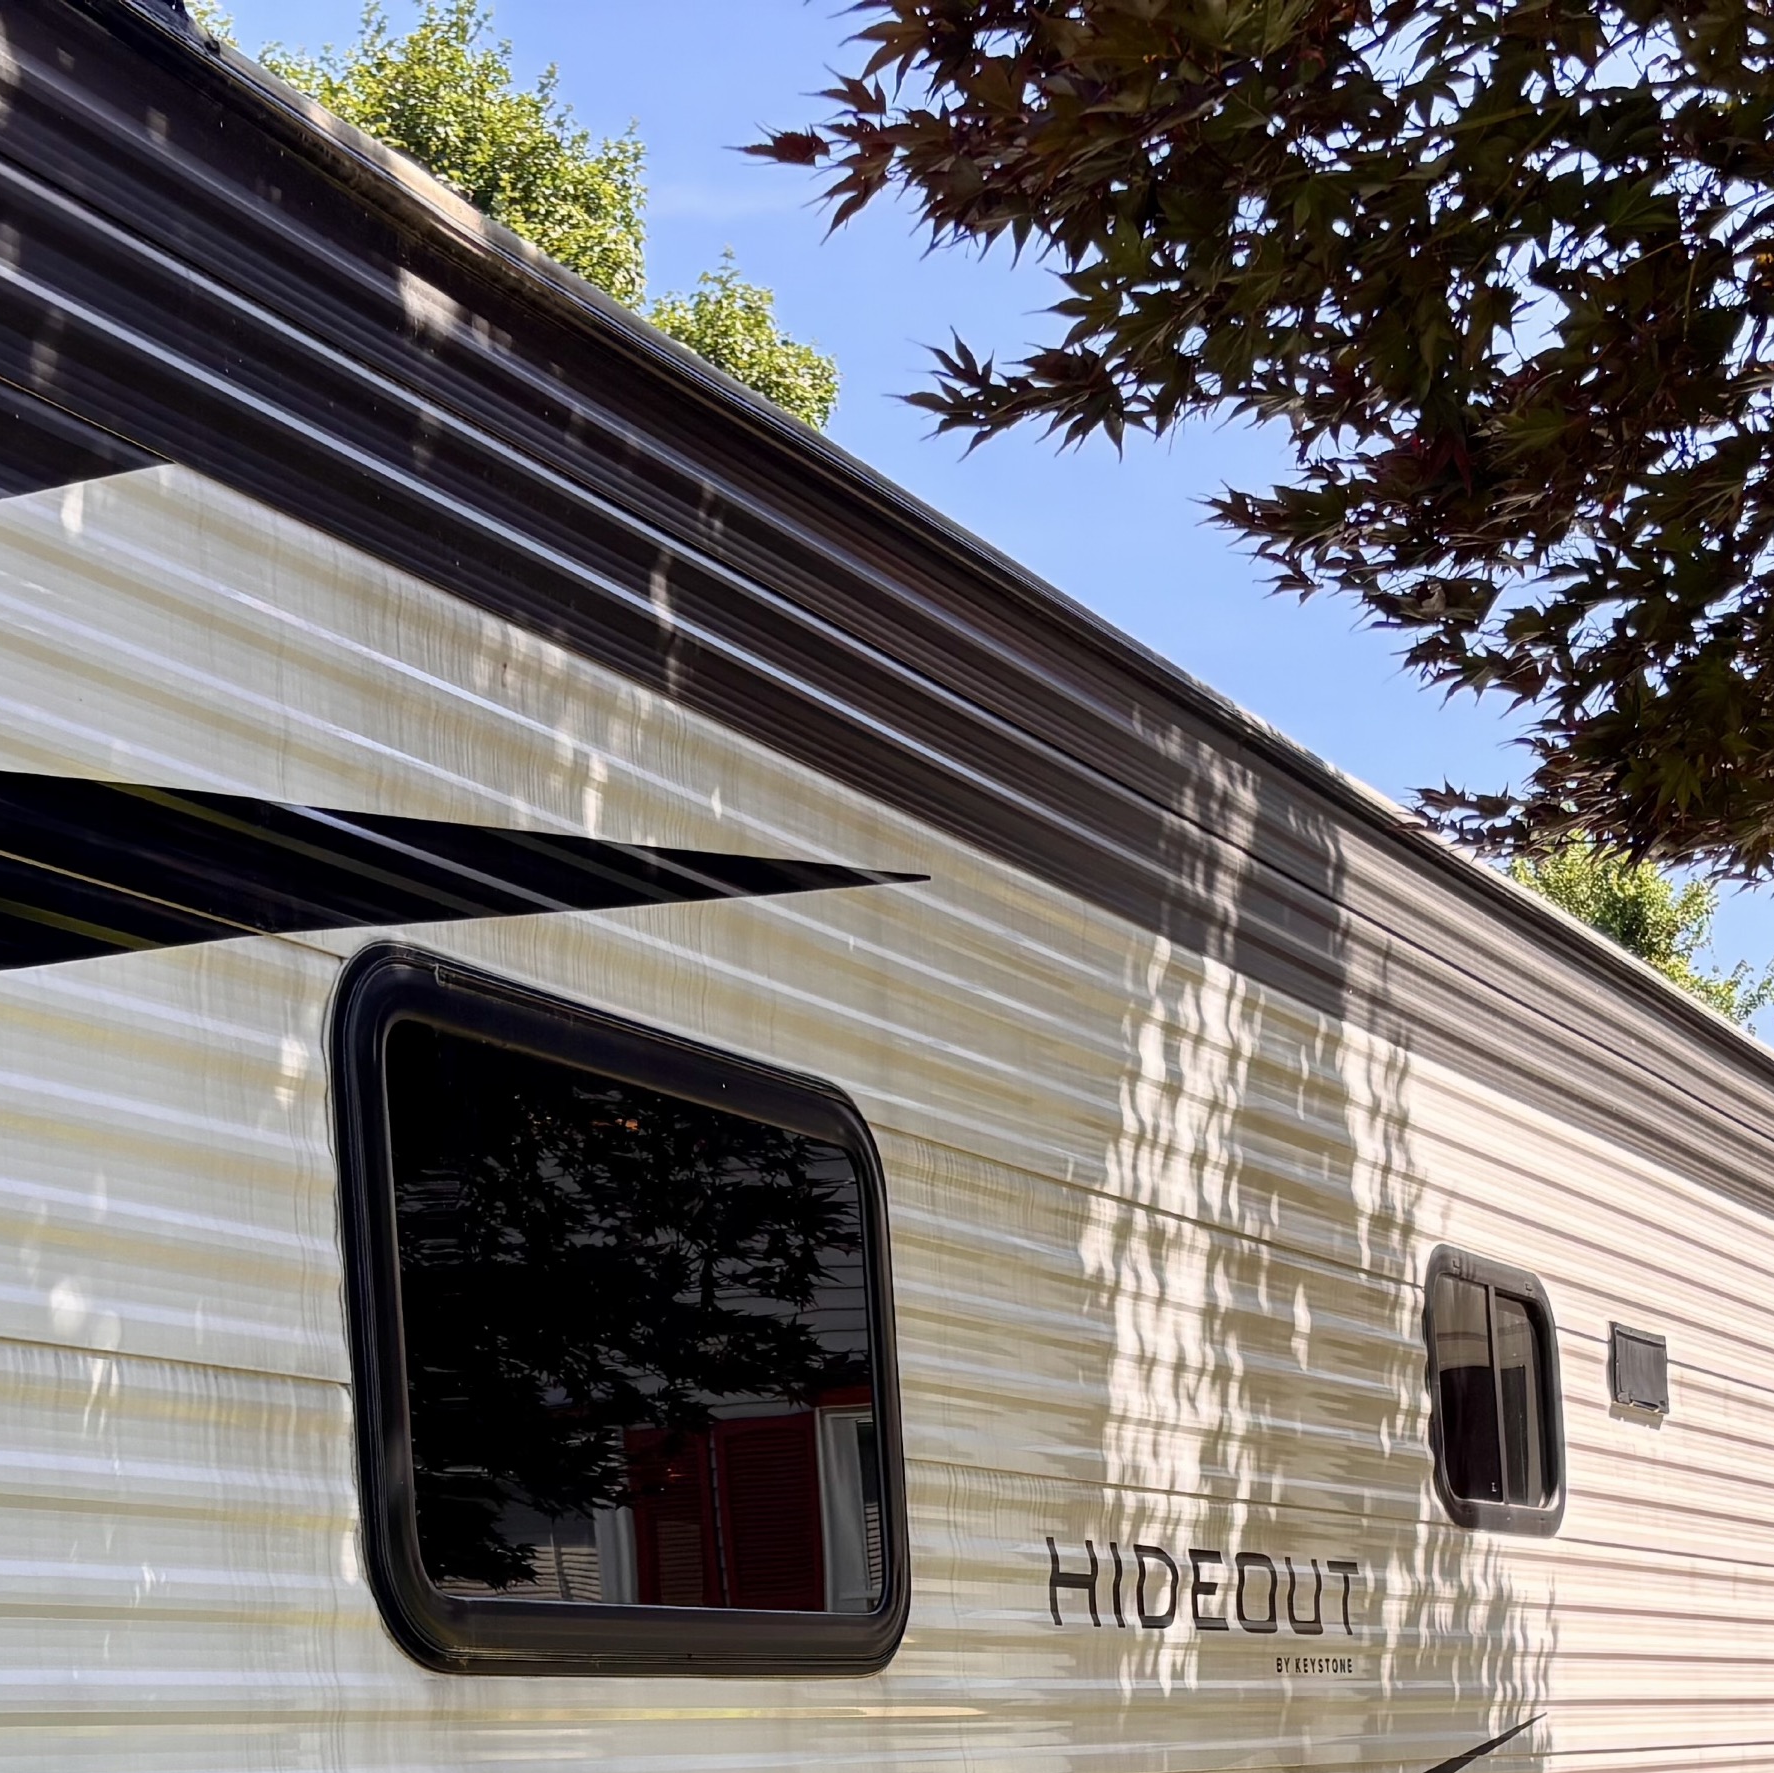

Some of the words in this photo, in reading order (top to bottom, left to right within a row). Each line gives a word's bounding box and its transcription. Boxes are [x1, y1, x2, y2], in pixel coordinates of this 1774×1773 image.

[1045, 1536, 1359, 1636] HIDEOUT
[1275, 1657, 1291, 1674] BY
[1295, 1657, 1353, 1674] KEYSTONE
